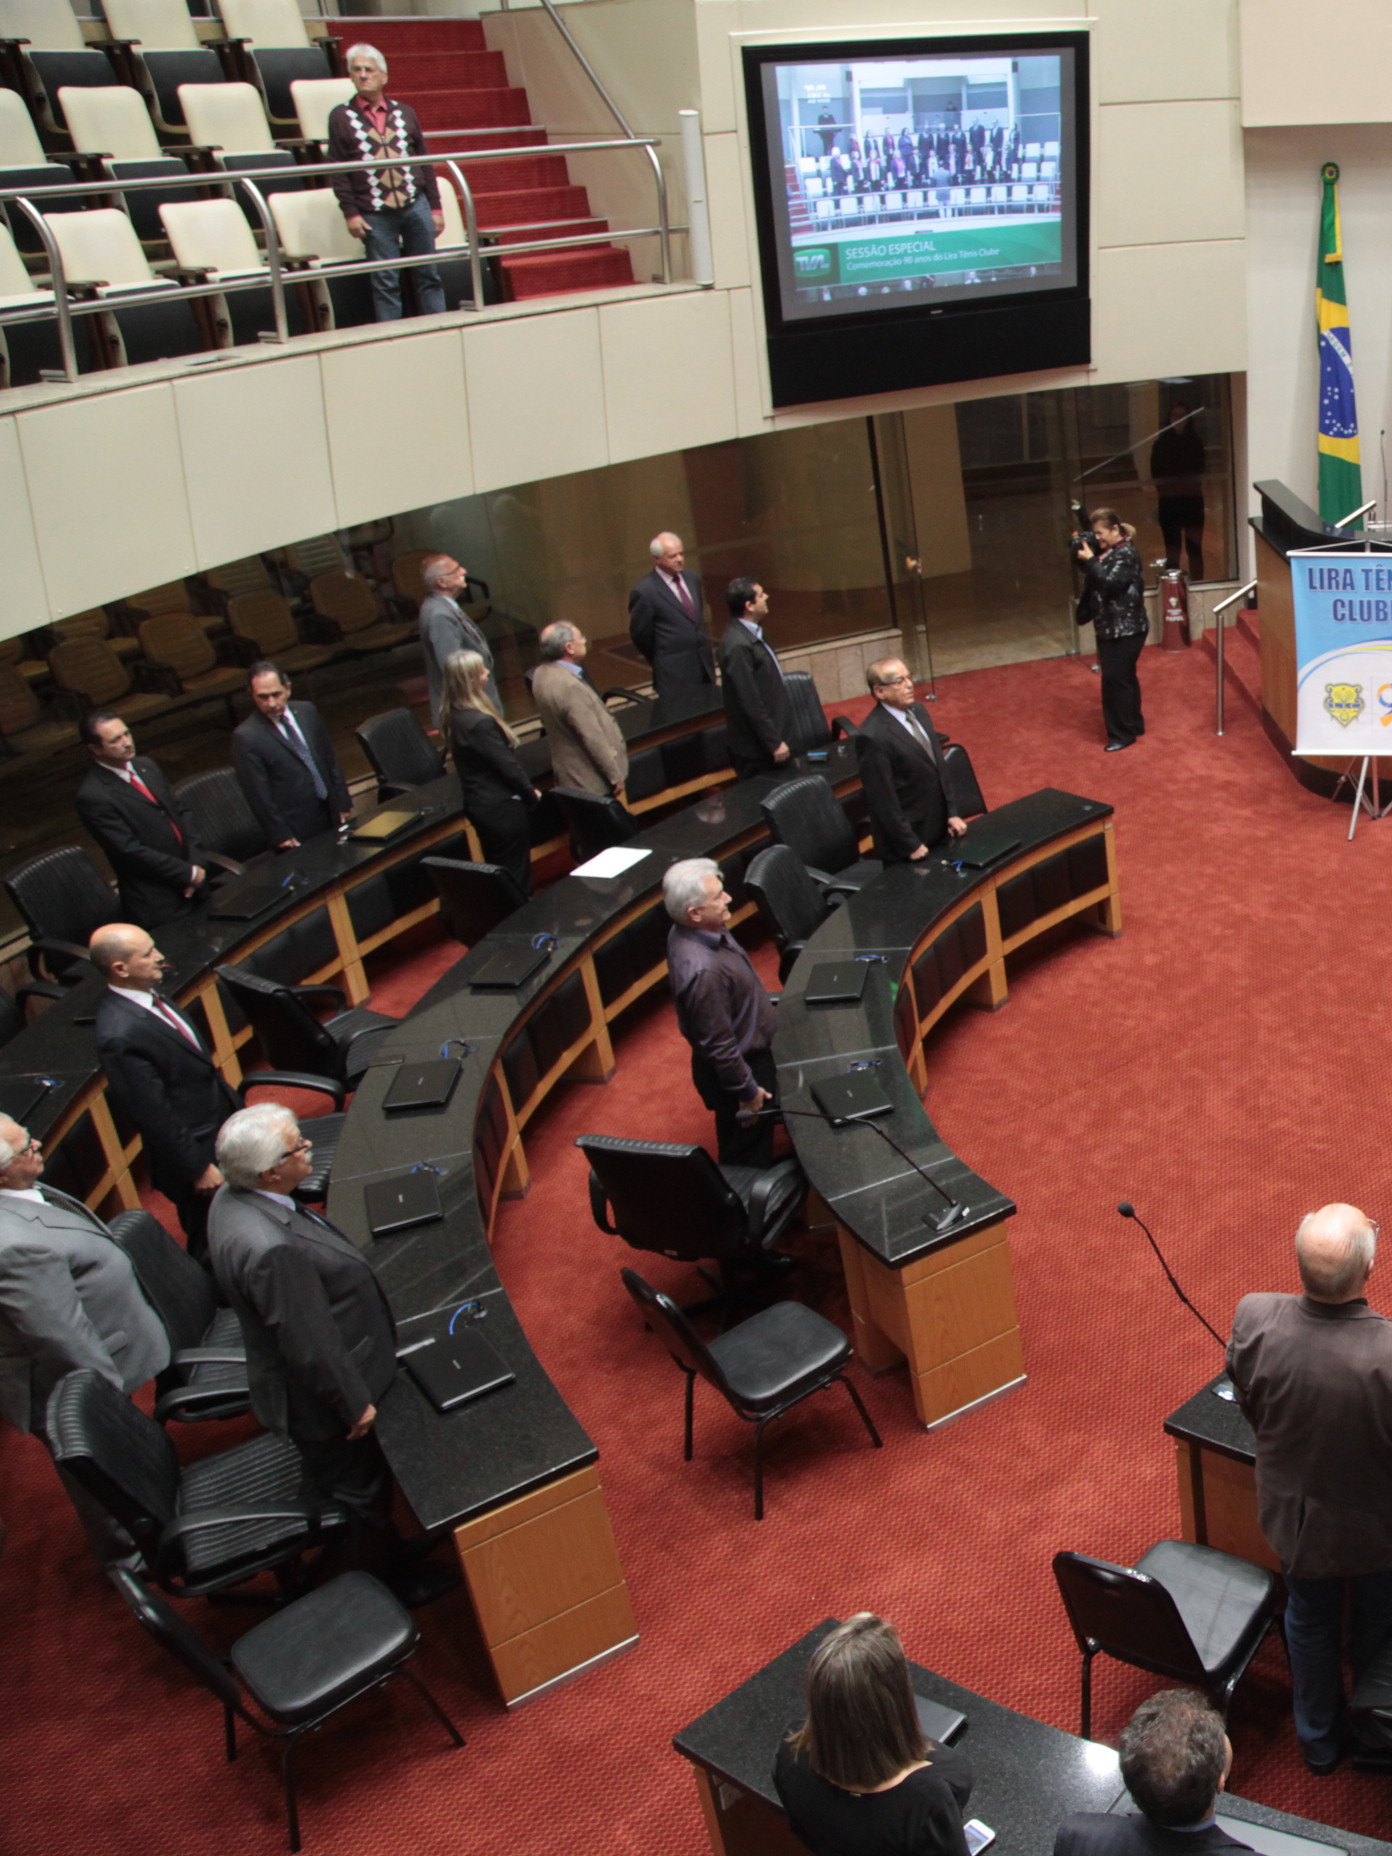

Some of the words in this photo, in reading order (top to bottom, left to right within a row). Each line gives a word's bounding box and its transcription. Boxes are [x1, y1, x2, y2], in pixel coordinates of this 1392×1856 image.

[845, 244, 886, 259] SESSÃO
[888, 241, 936, 255] ESPECIAL
[847, 257, 902, 271] Comemoração
[903, 256, 913, 264] 90
[933, 253, 943, 261] do
[944, 252, 958, 260] Lira
[979, 247, 1000, 256] Clube
[1308, 567, 1355, 591] LIRA
